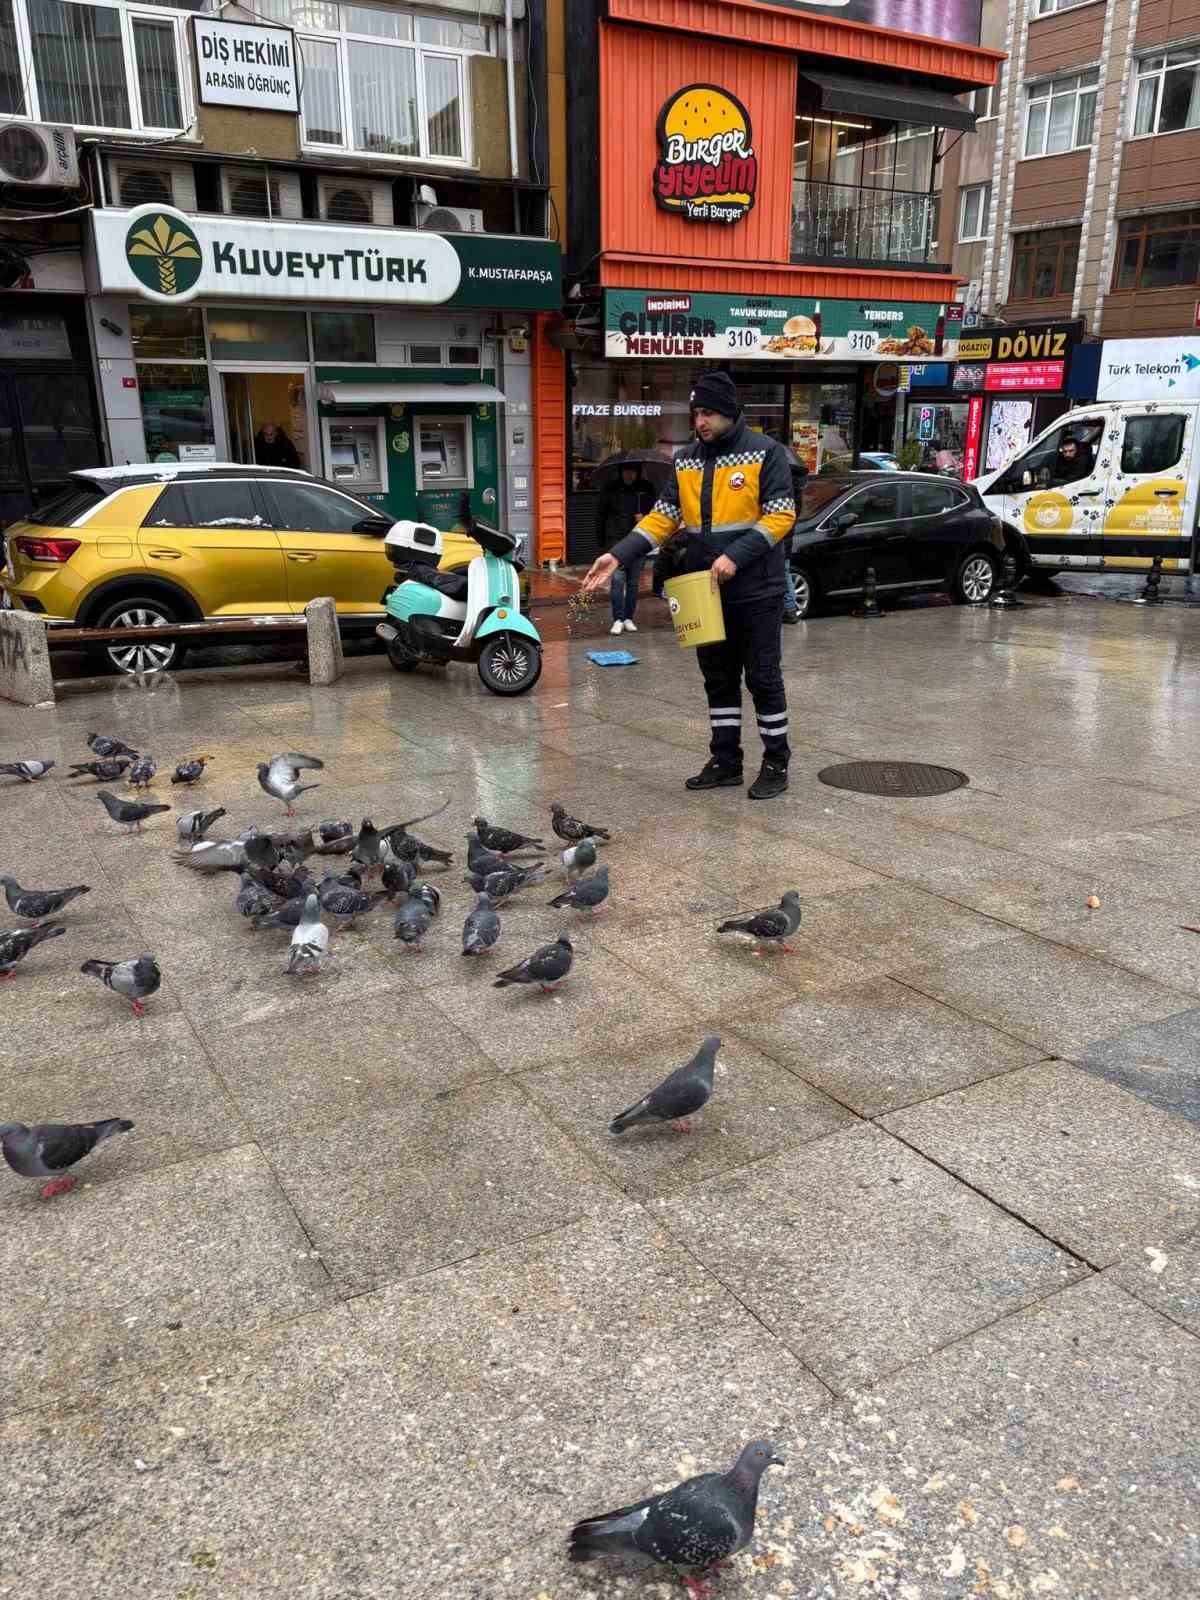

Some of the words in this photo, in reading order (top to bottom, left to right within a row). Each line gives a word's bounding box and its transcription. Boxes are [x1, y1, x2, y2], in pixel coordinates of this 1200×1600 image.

[201, 32, 229, 66] DİŞ
[233, 38, 290, 68] HEKİMİ
[205, 71, 245, 90] ARASİN
[247, 72, 291, 98] ÖĞRÜNÇ
[687, 202, 708, 217] Yerli
[710, 204, 742, 222] Burger
[468, 266, 553, 284] K.MUSTAFAPAŞA
[730, 307, 757, 317] TAVUK
[757, 309, 788, 318] BURGER
[864, 310, 904, 321] TENDERS
[626, 337, 704, 356] MENÜLER
[998, 328, 1067, 359] DÖVİZ
[1108, 364, 1131, 375] Türk
[1135, 363, 1181, 375] Telekom
[613, 404, 661, 416] BURGER
